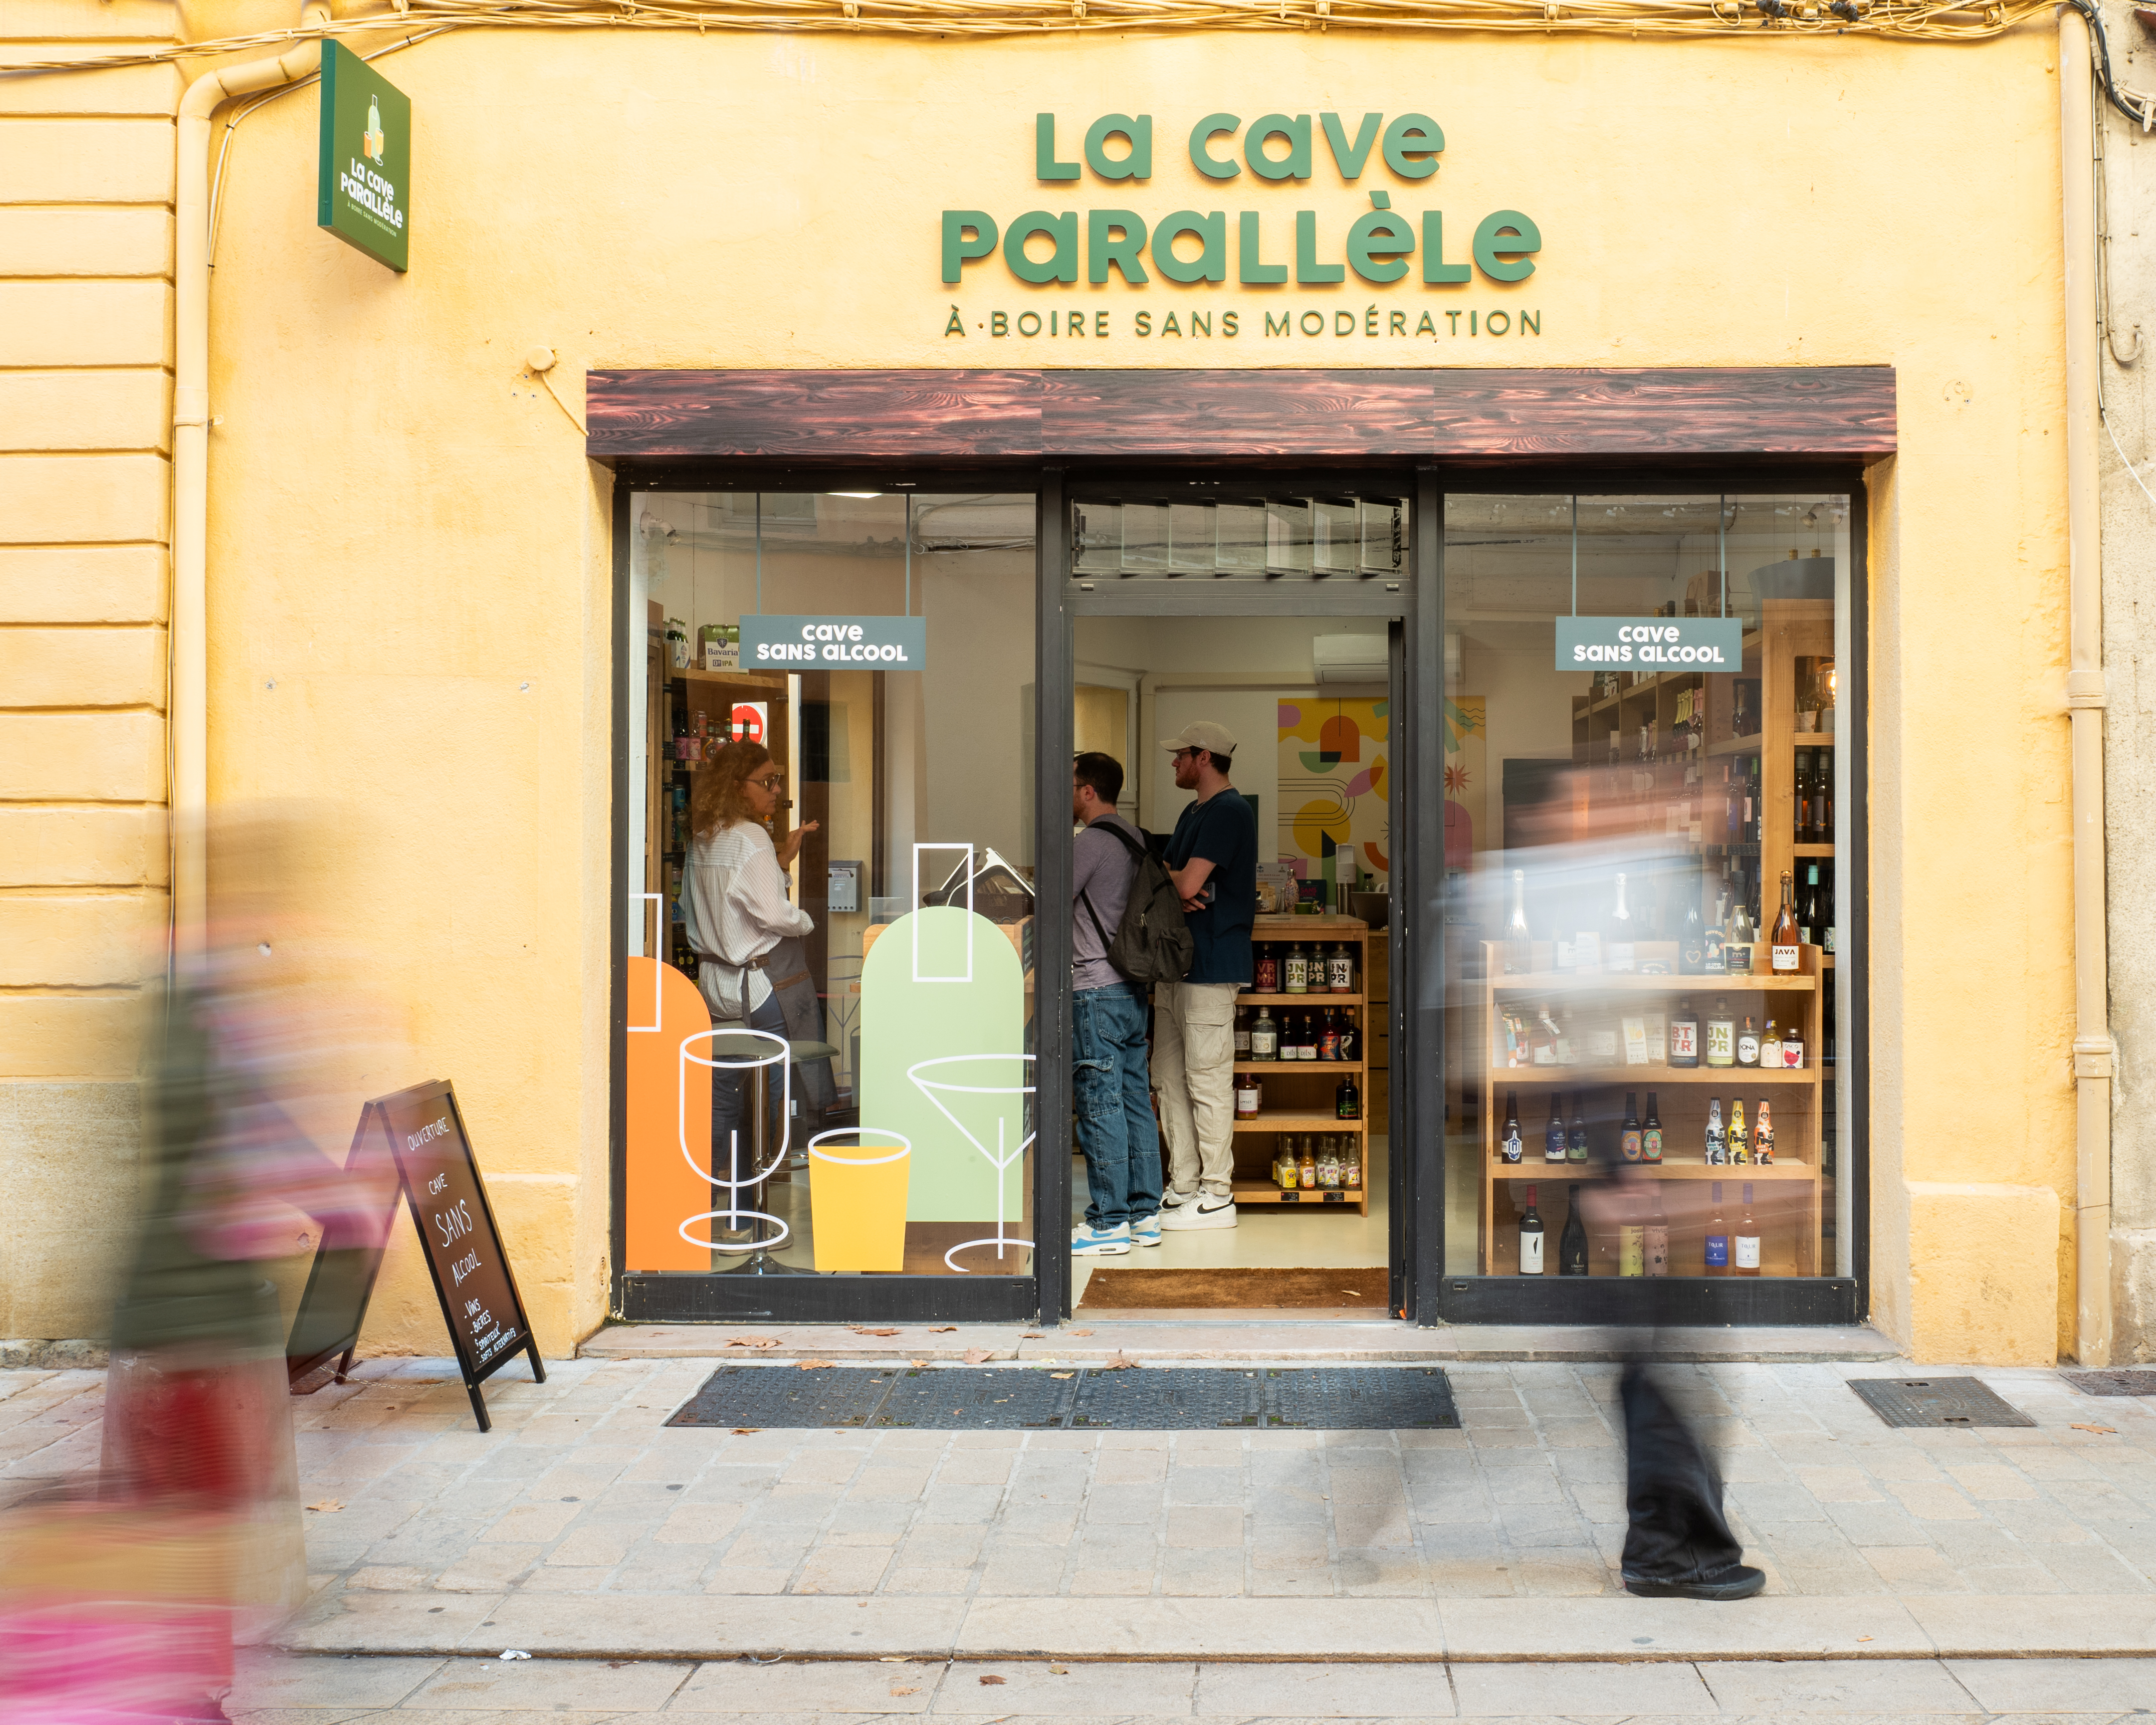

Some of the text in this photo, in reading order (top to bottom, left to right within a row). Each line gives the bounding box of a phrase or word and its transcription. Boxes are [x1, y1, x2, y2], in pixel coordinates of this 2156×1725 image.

[351, 204, 363, 216] BOIRE
[363, 211, 373, 222] SANS
[944, 303, 1541, 337] À BOIRE SANS MODÉRATION
[802, 624, 863, 641] cave
[1618, 626, 1680, 643] cave
[1672, 1026, 1691, 1039] BT
[1708, 1026, 1727, 1039] JN
[1672, 1039, 1691, 1052] TR
[1708, 1039, 1728, 1052] PR
[408, 1117, 449, 1151] OUVERTURE
[429, 1173, 448, 1195] CAVE
[435, 1199, 472, 1248] SANS
[452, 1248, 481, 1288] ALCOOL
